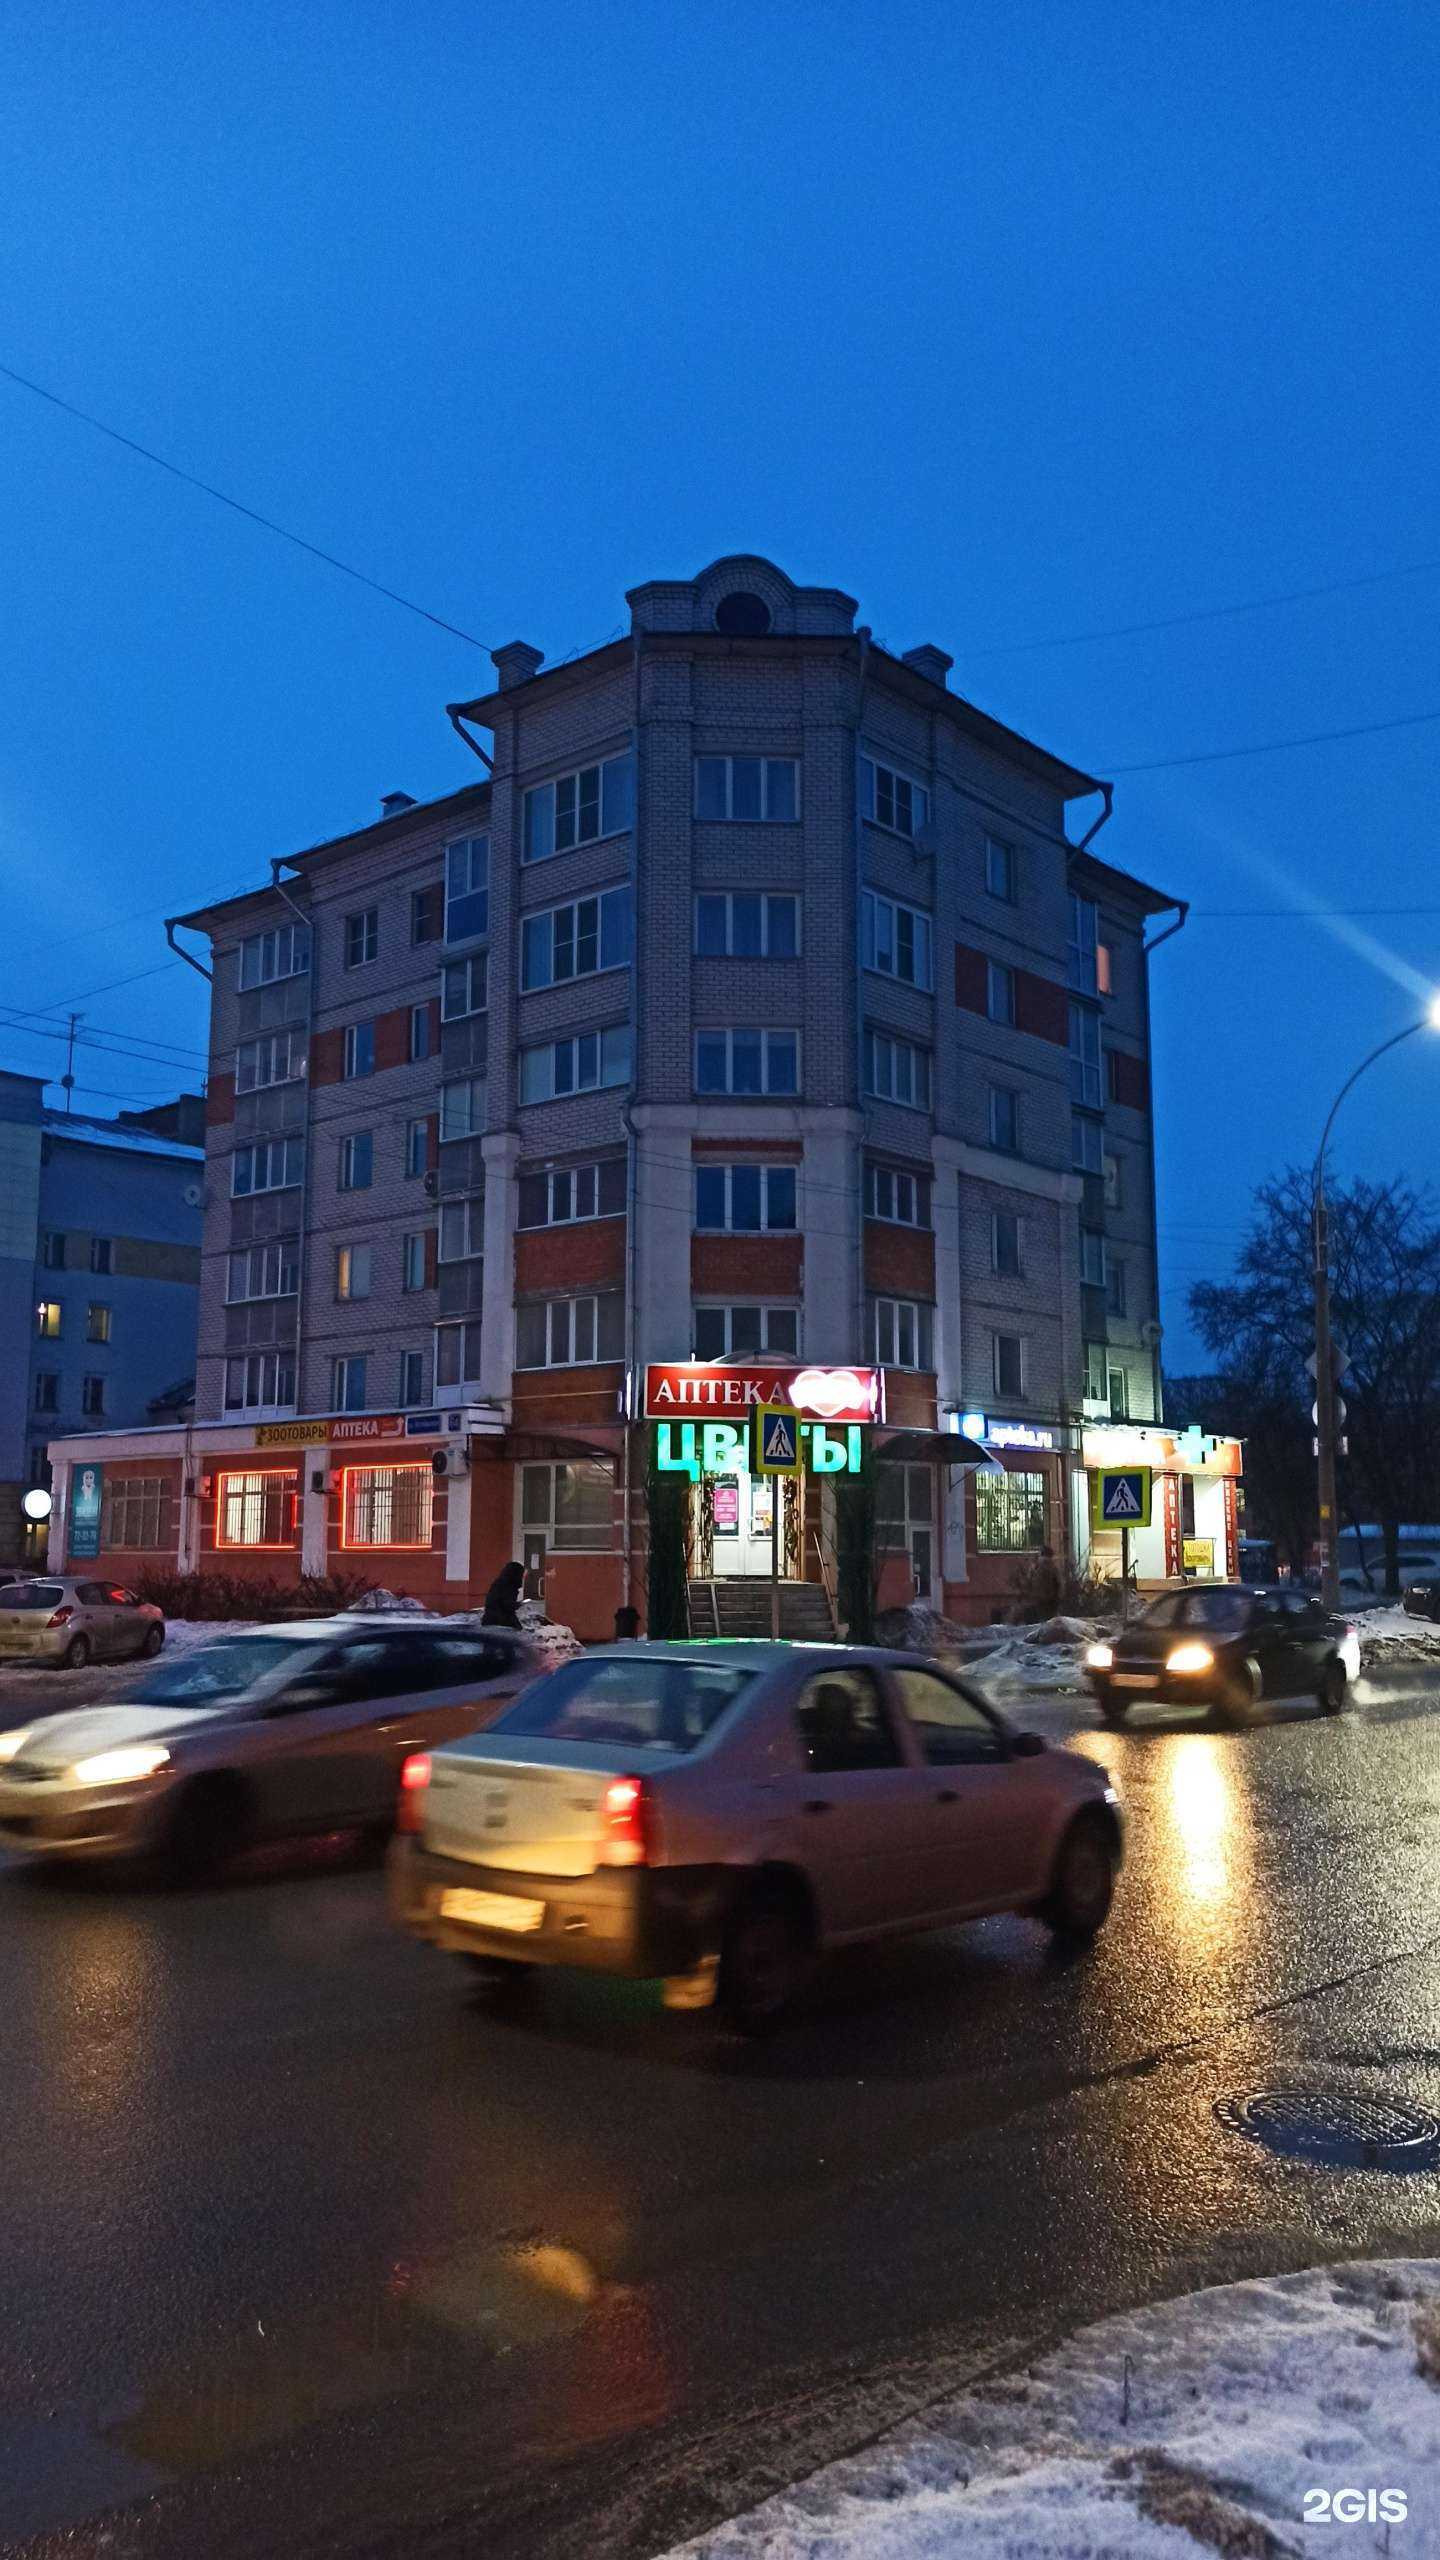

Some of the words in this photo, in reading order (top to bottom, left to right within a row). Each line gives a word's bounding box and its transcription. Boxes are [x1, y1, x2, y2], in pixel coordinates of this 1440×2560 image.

[653, 1378, 788, 1405] АПТЕКА
[267, 1424, 327, 1441] ЗООТОВАРЫ
[332, 1420, 379, 1438] АПТЕКА
[657, 1423, 862, 1482] ЦВЫ
[1168, 1479, 1179, 1575] АПТЕКА
